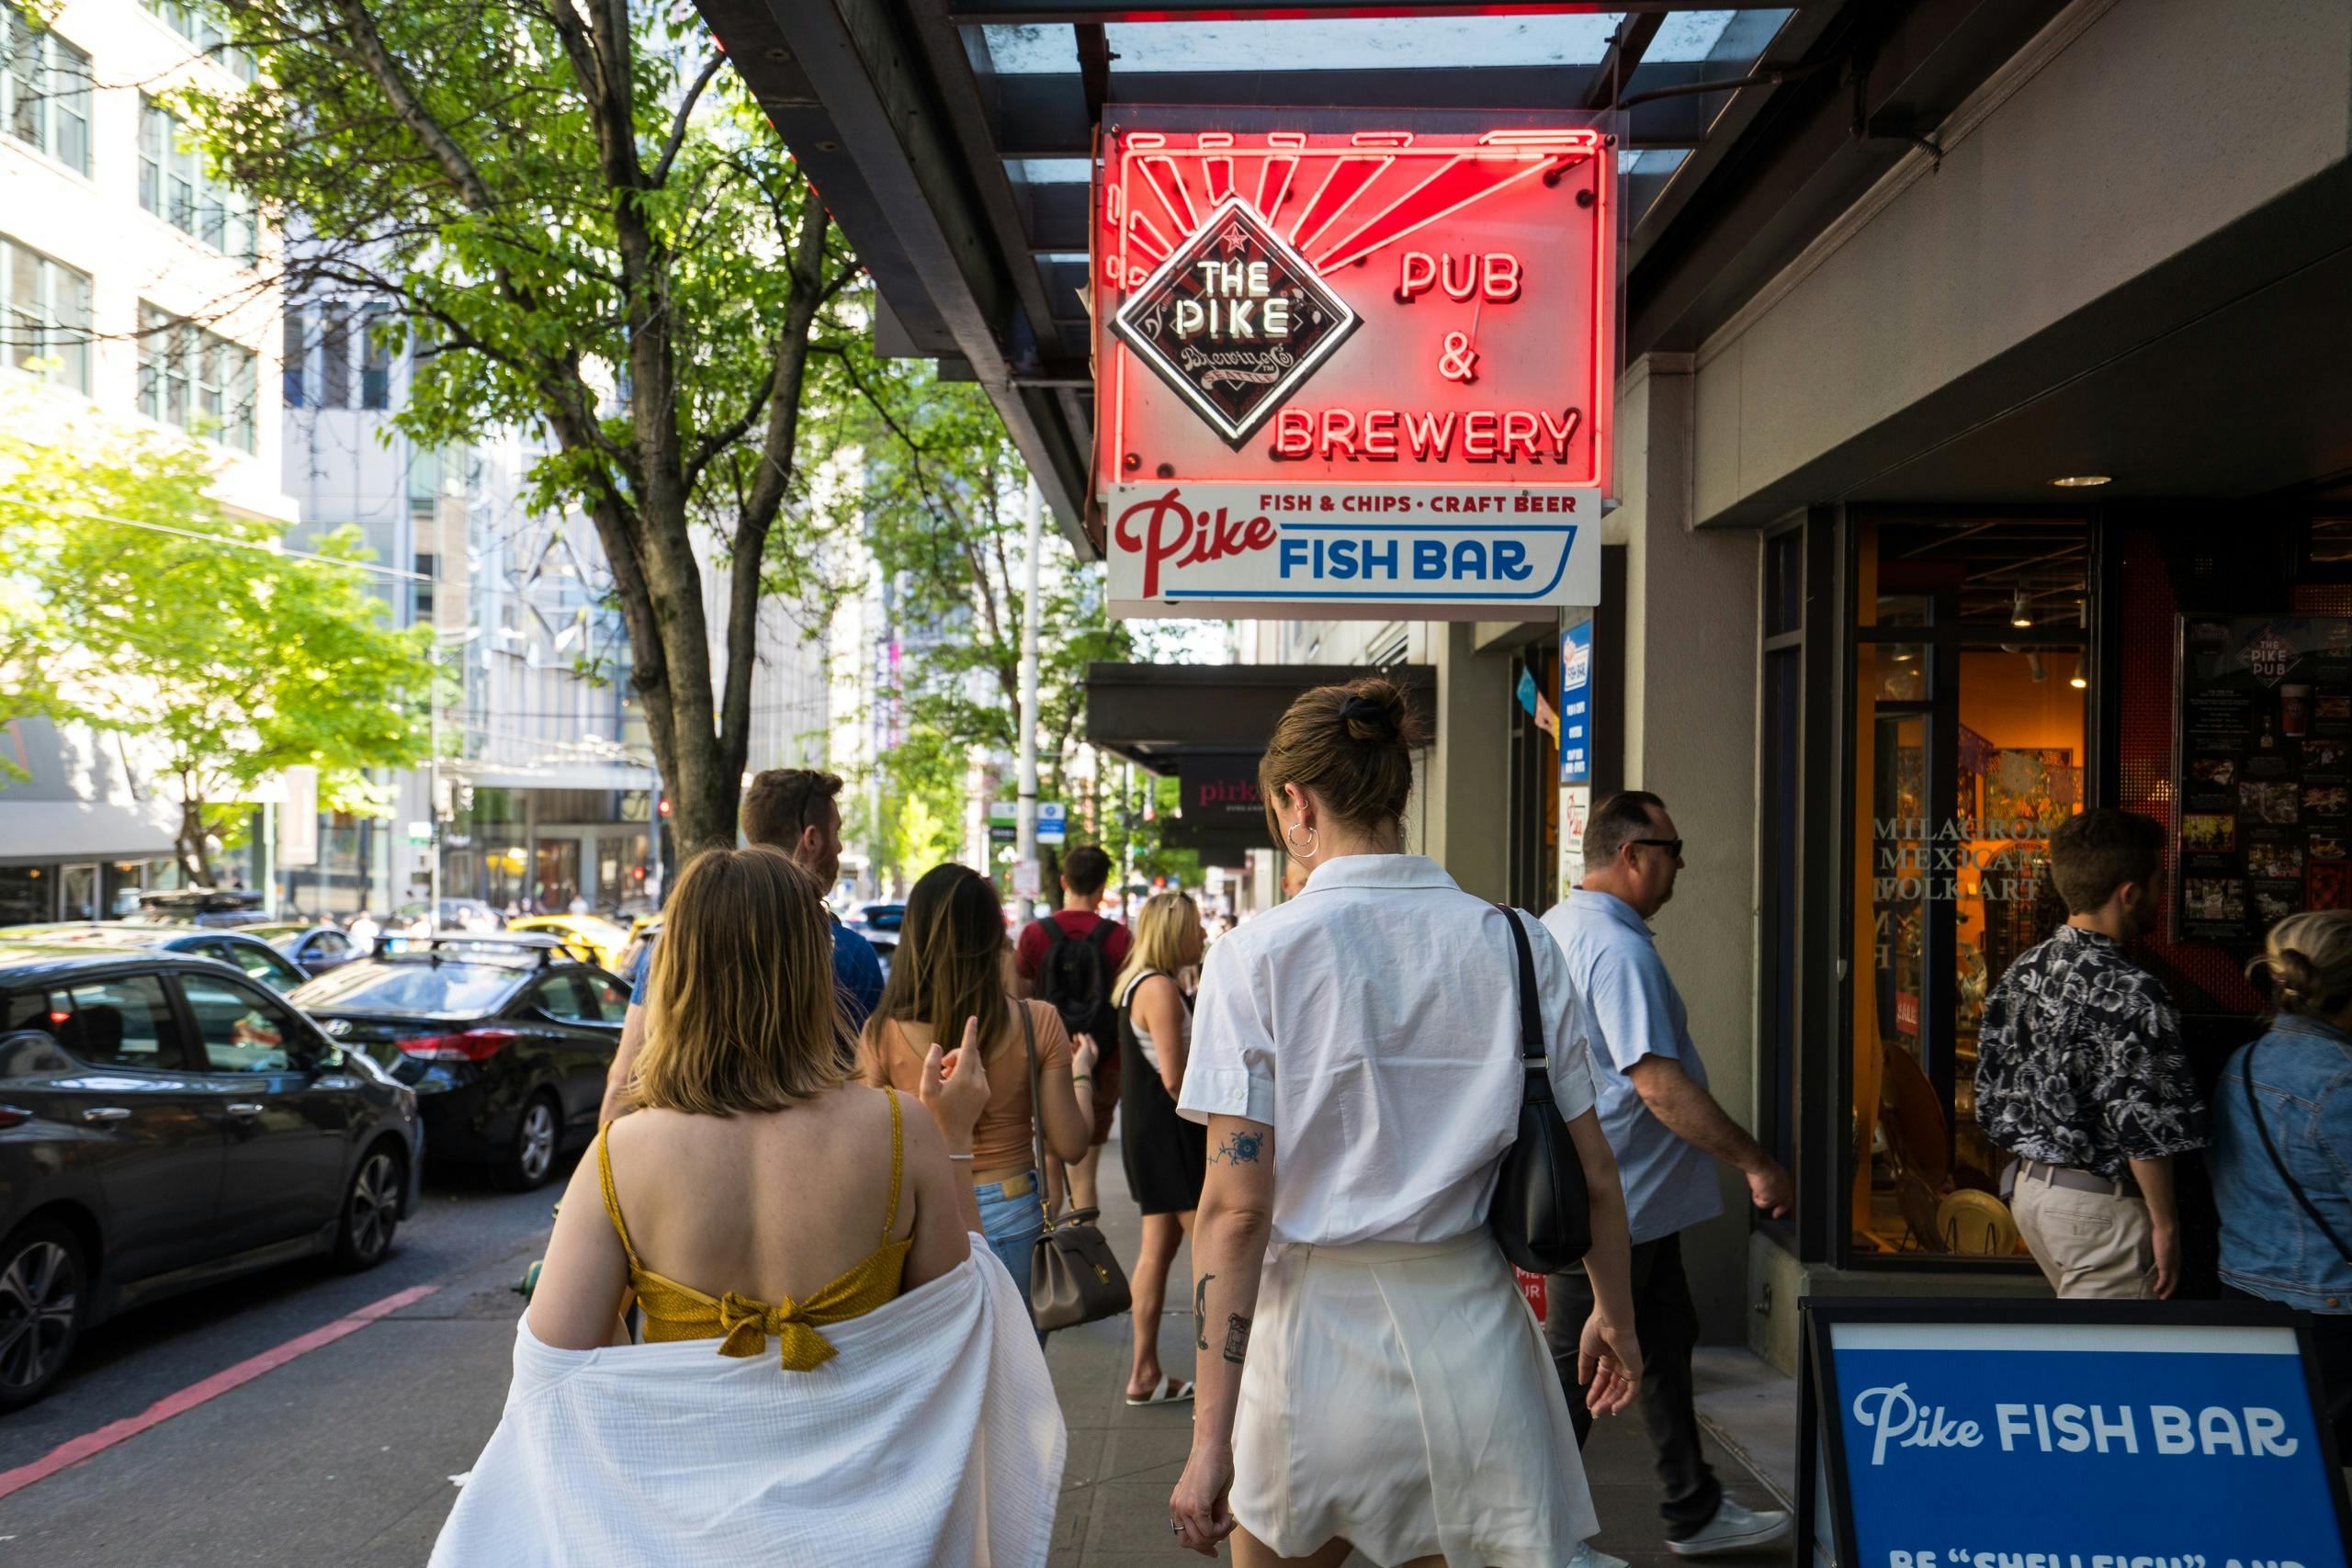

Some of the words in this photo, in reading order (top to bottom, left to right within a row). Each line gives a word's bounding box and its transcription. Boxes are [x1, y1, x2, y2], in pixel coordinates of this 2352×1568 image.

[1197, 262, 1270, 297] THE
[1401, 252, 1521, 302] PUB
[1176, 299, 1288, 338] PIKE
[1438, 331, 1476, 380] &
[1204, 370, 1273, 383] SEATTLE
[1276, 409, 1578, 459] BREWERY
[1260, 494, 1312, 512] FISH
[1319, 495, 1335, 512] &
[1341, 496, 1411, 513] CHIPS
[1430, 496, 1507, 513] CRAFT
[1514, 496, 1576, 513] BEER
[1114, 488, 1278, 599] Pike
[1280, 538, 1397, 580] FISH
[1413, 539, 1533, 581] BAR
[2251, 649, 2287, 661] PIKE
[2260, 640, 2279, 649] THE
[2254, 663, 2286, 675] PUB
[1881, 847, 2044, 871] MEXICAN
[1879, 877, 1964, 901] FOLK
[1978, 877, 2041, 901] ART
[1896, 1001, 1918, 1025] SALE
[1852, 1382, 1984, 1466] Pike
[1996, 1404, 2139, 1453] FISH
[2150, 1404, 2299, 1458] BAR
